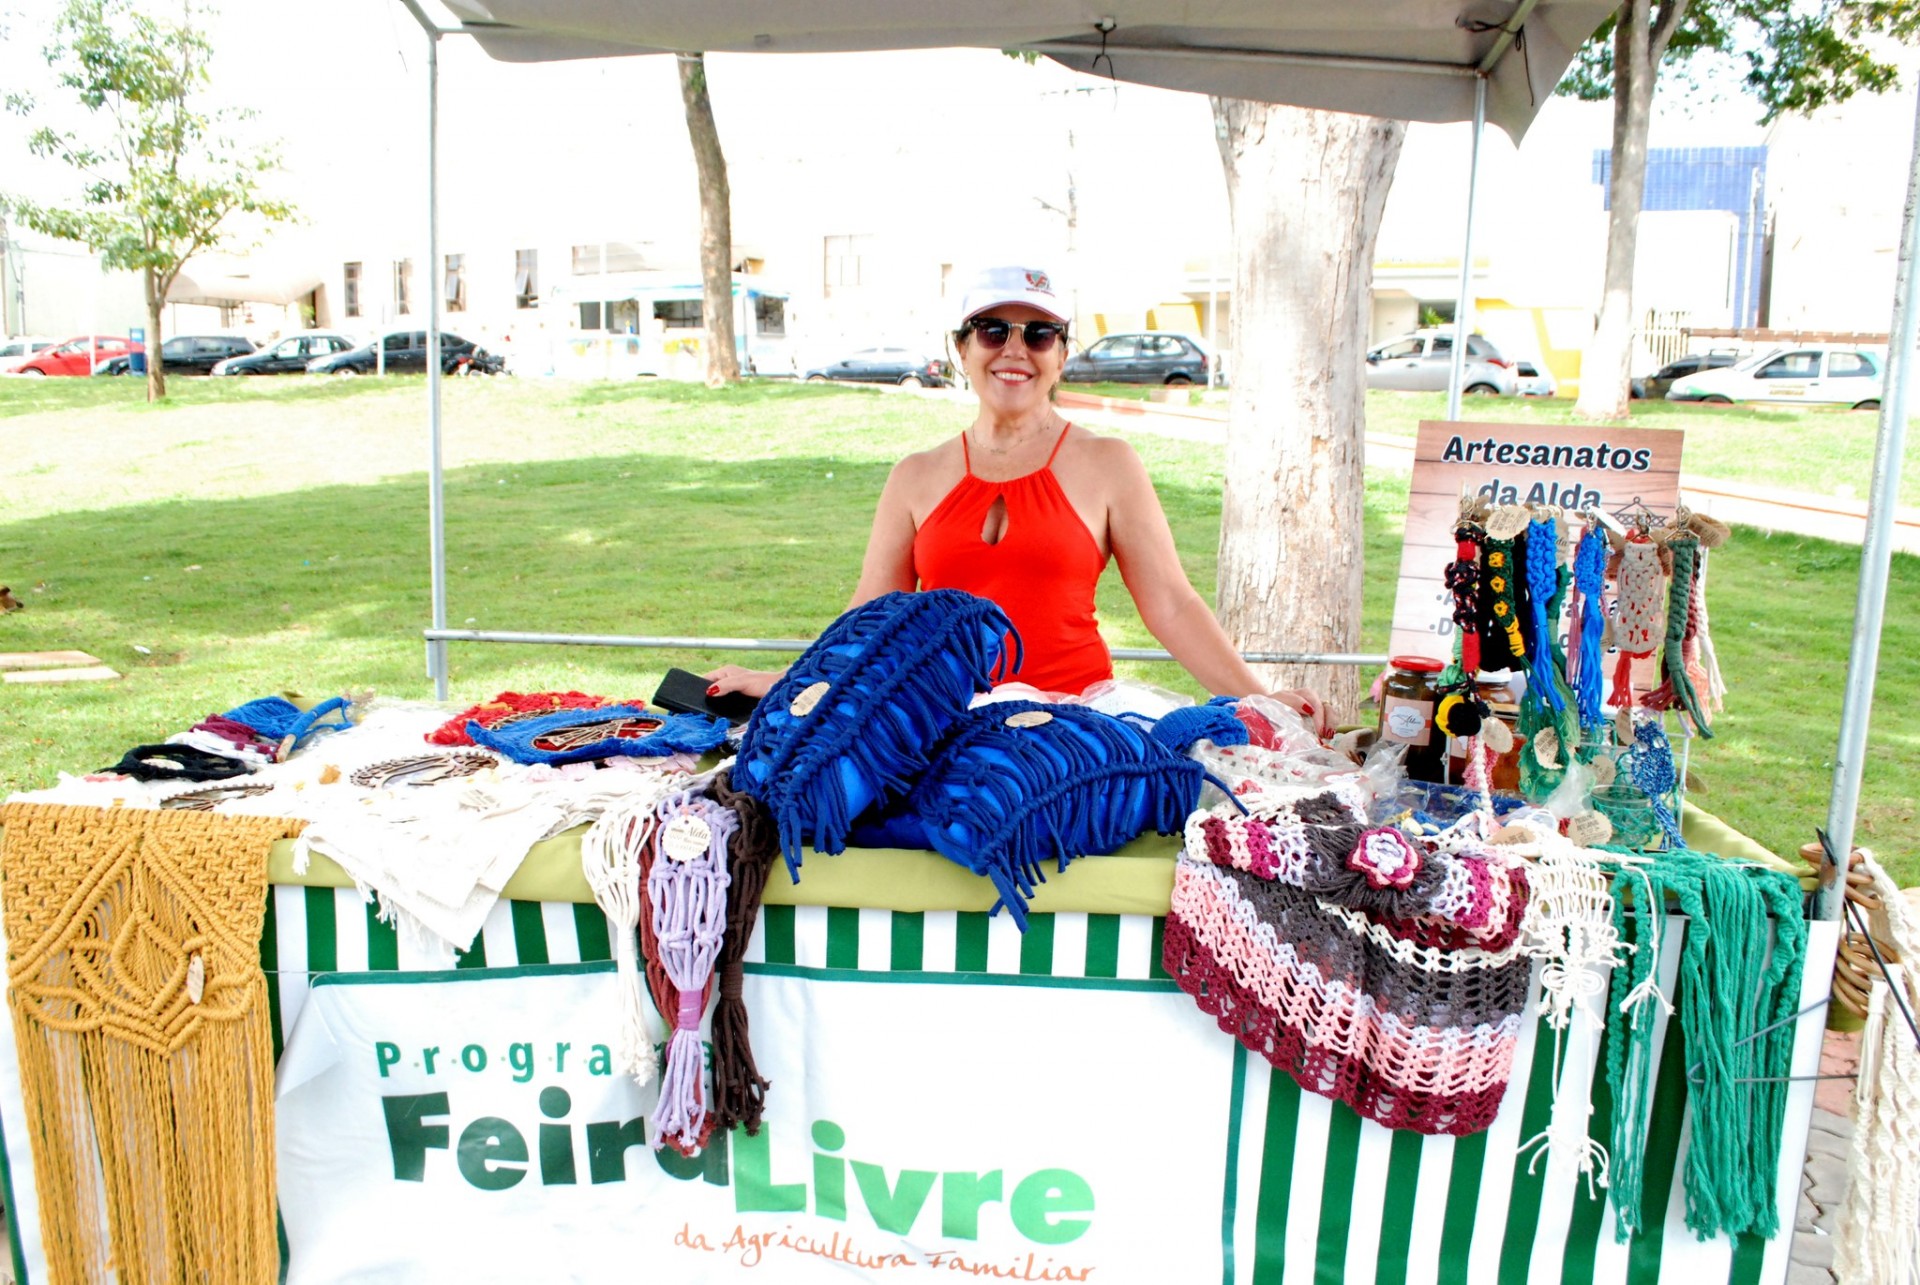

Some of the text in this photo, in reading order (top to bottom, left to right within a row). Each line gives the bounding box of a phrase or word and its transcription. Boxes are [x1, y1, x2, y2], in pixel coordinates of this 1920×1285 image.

[1442, 436, 1651, 471] Artesanatos
[1478, 478, 1601, 511] da Alda
[730, 1120, 1096, 1246] Livre
[673, 1223, 1098, 1283] da Agricultura Familiar
